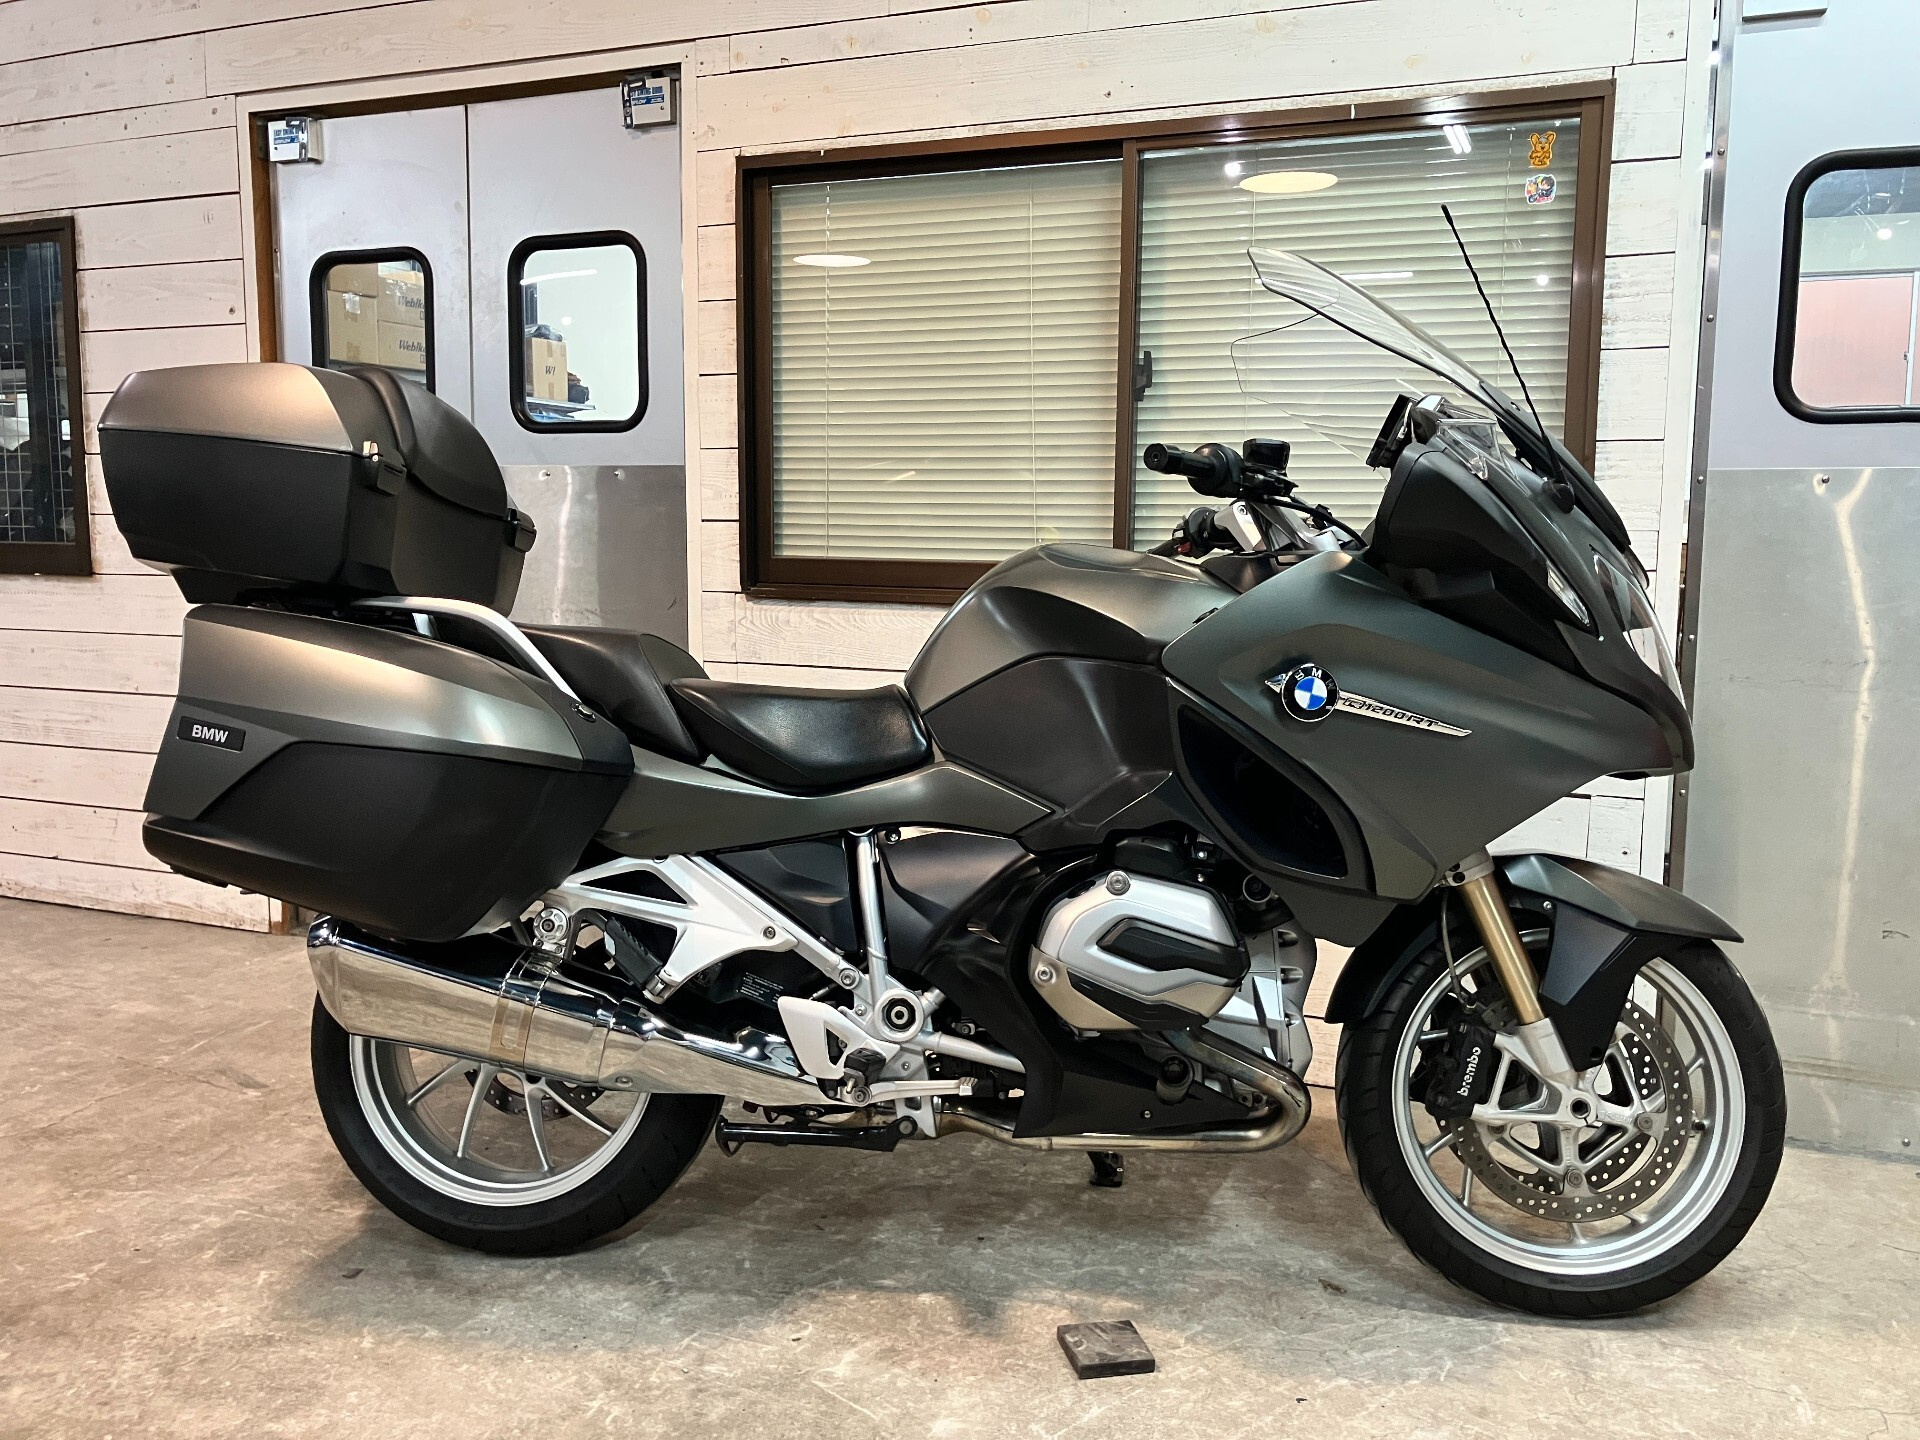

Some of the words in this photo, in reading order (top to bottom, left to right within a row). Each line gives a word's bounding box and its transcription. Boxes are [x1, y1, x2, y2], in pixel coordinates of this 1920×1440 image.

[1294, 667, 1336, 690] BMW
[192, 724, 229, 743] BMW
[1456, 1046, 1482, 1096] brembo
